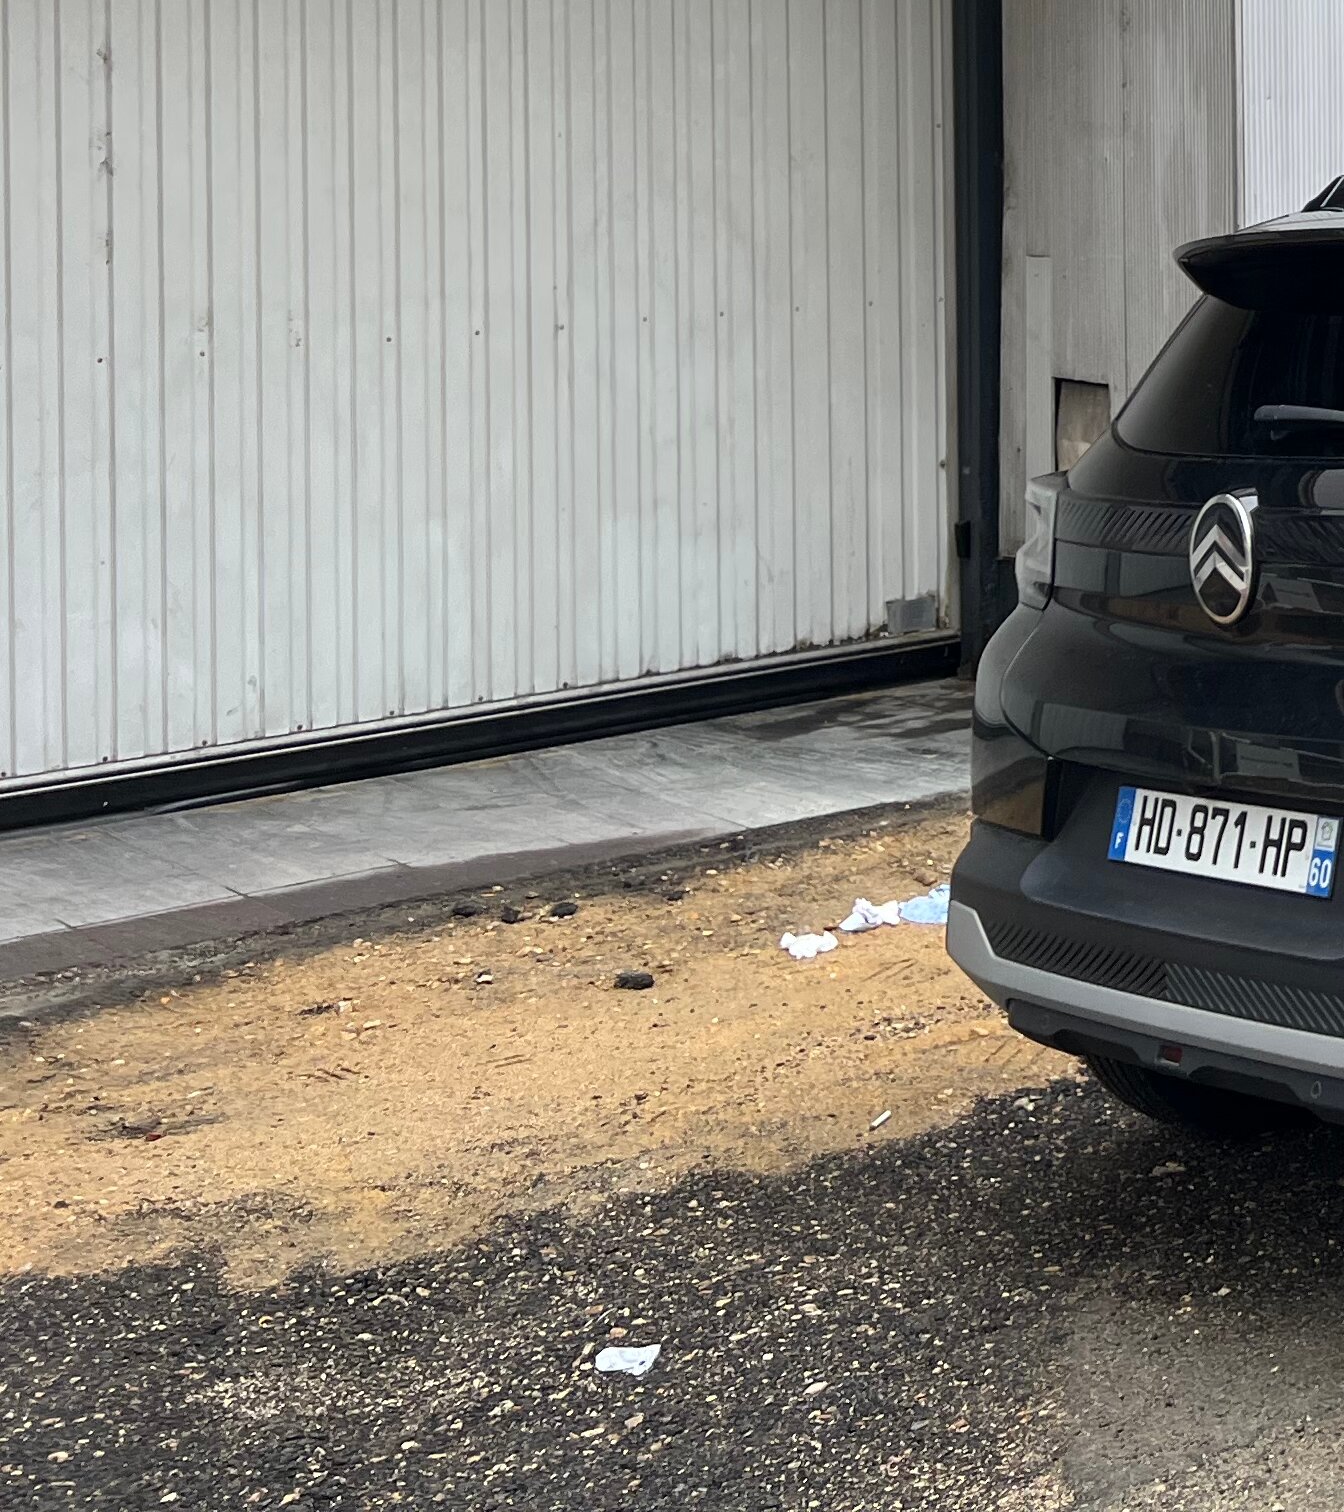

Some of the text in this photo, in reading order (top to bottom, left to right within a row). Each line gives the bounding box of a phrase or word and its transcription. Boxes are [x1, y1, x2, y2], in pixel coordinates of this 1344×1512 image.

[1114, 795, 1333, 889] F HD-871-HP 60
